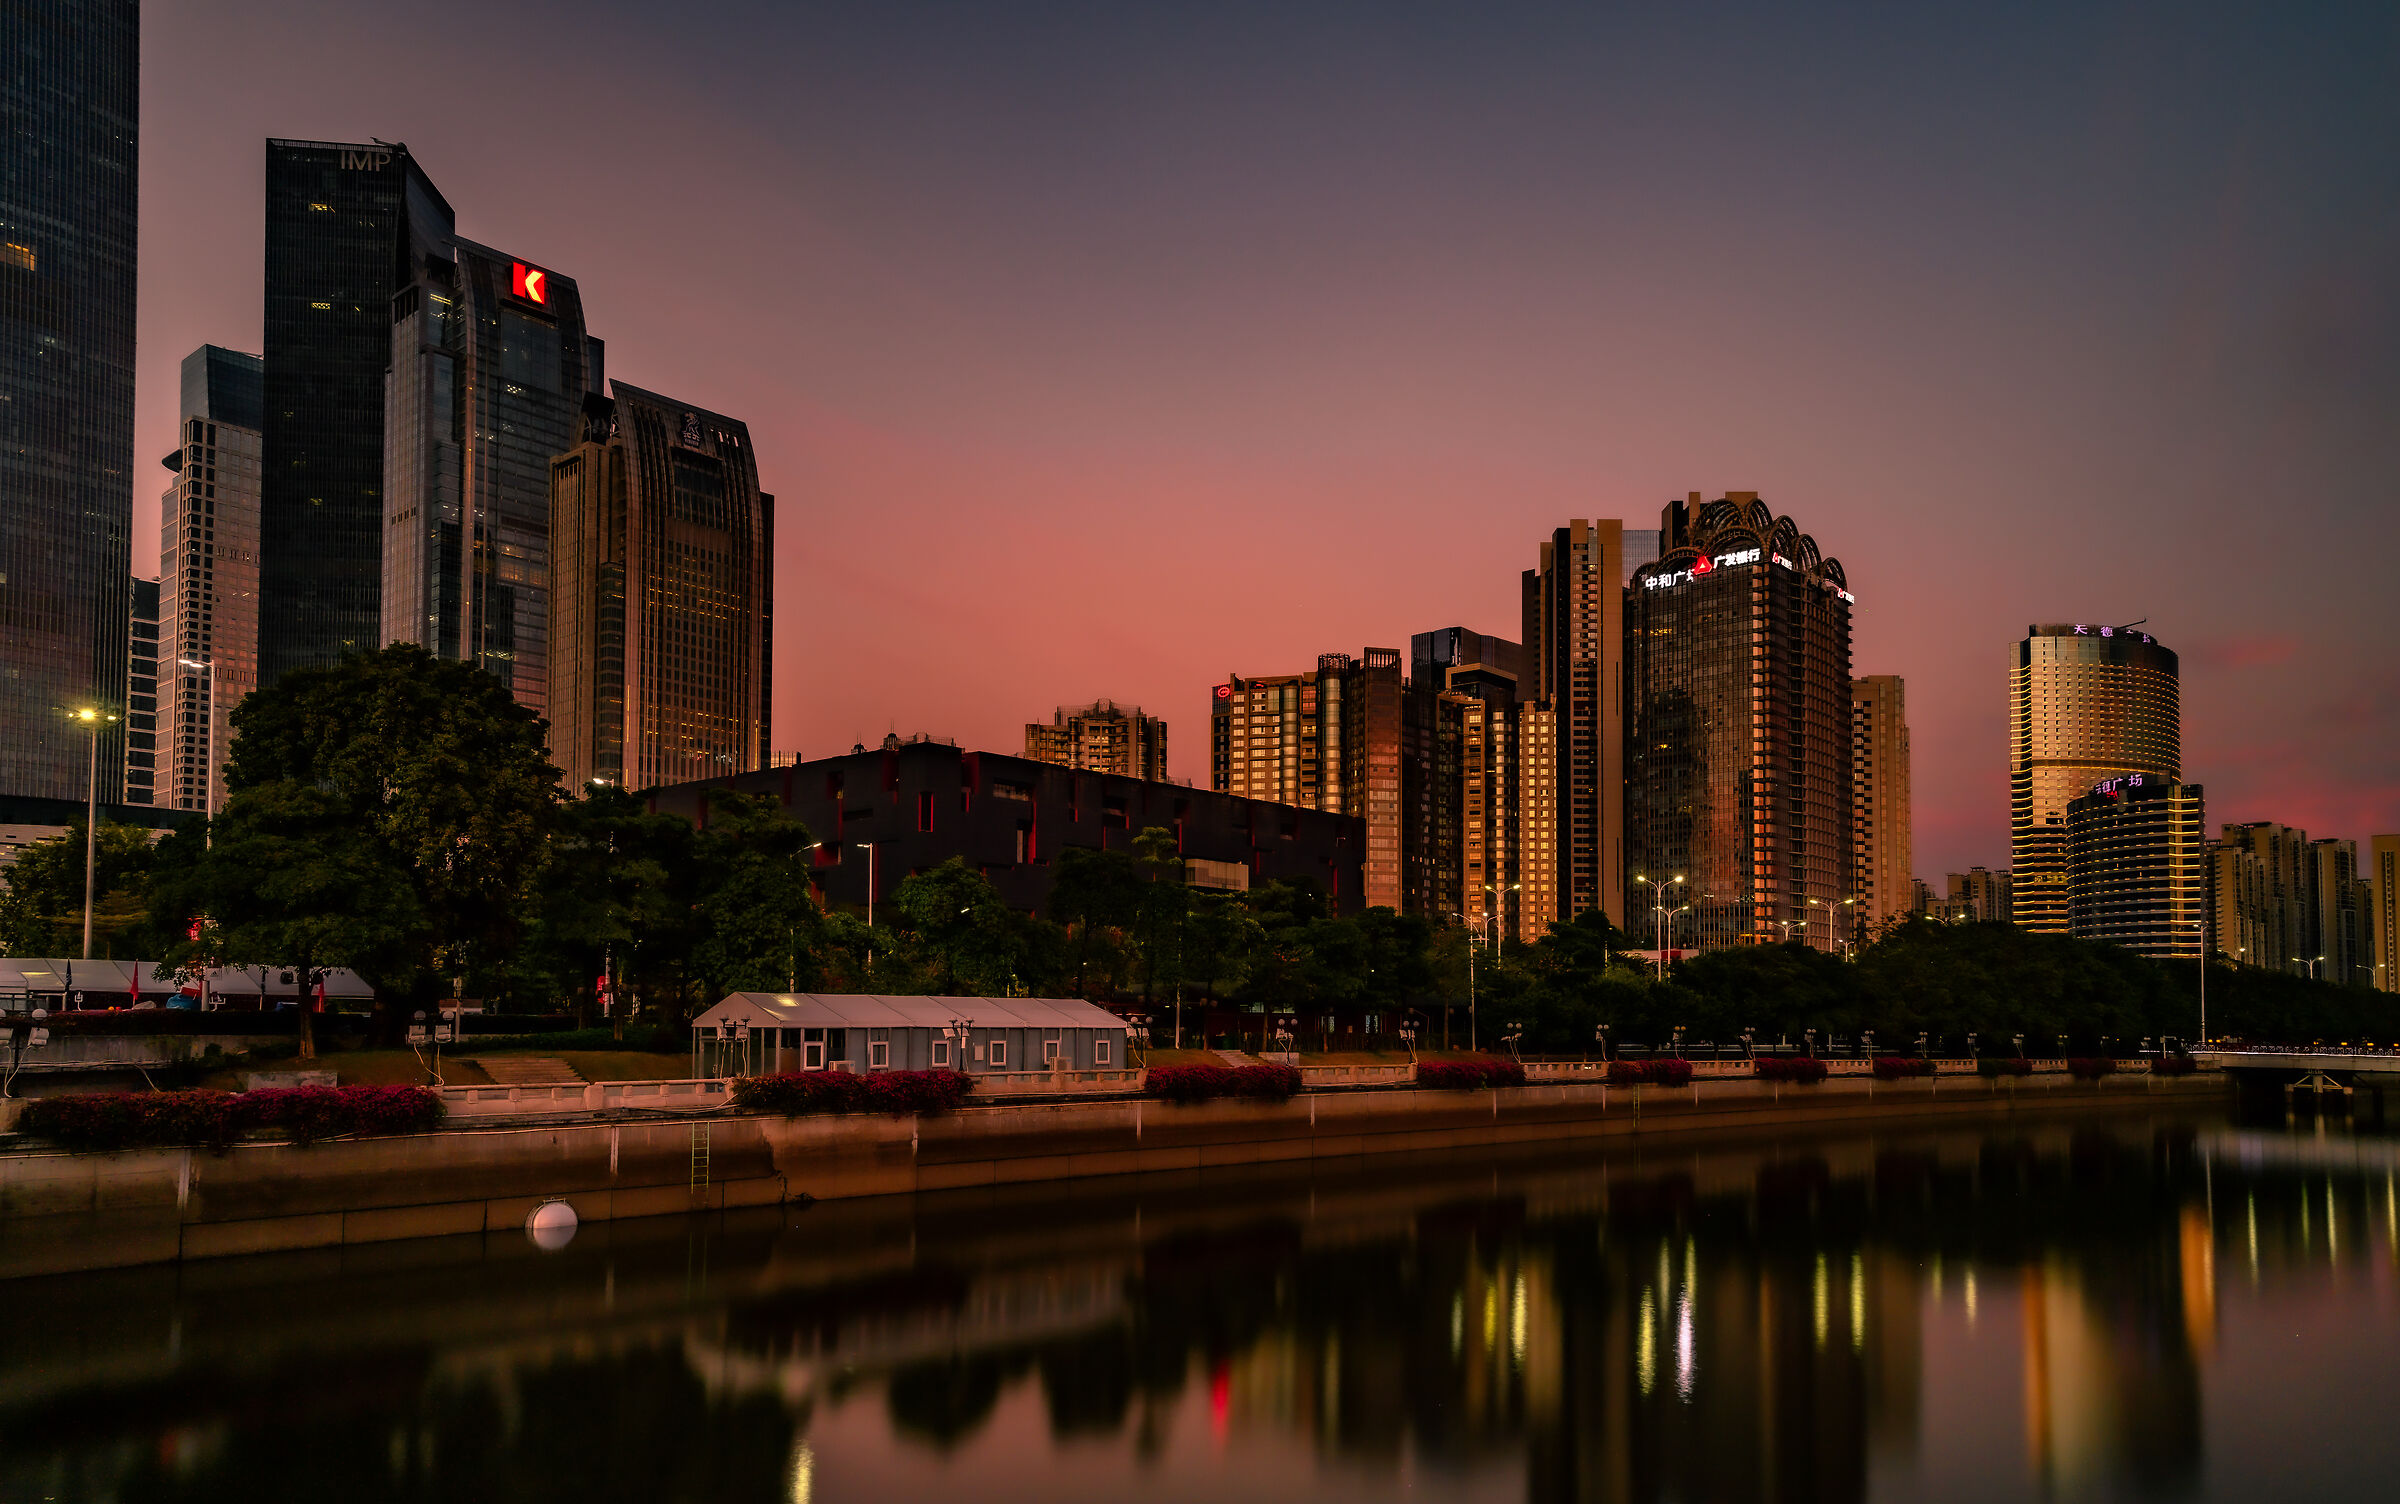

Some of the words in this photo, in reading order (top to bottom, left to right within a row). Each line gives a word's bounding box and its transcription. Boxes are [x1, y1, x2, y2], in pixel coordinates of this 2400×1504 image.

[340, 151, 391, 172] IMP
[1713, 548, 1761, 568] 广发银行
